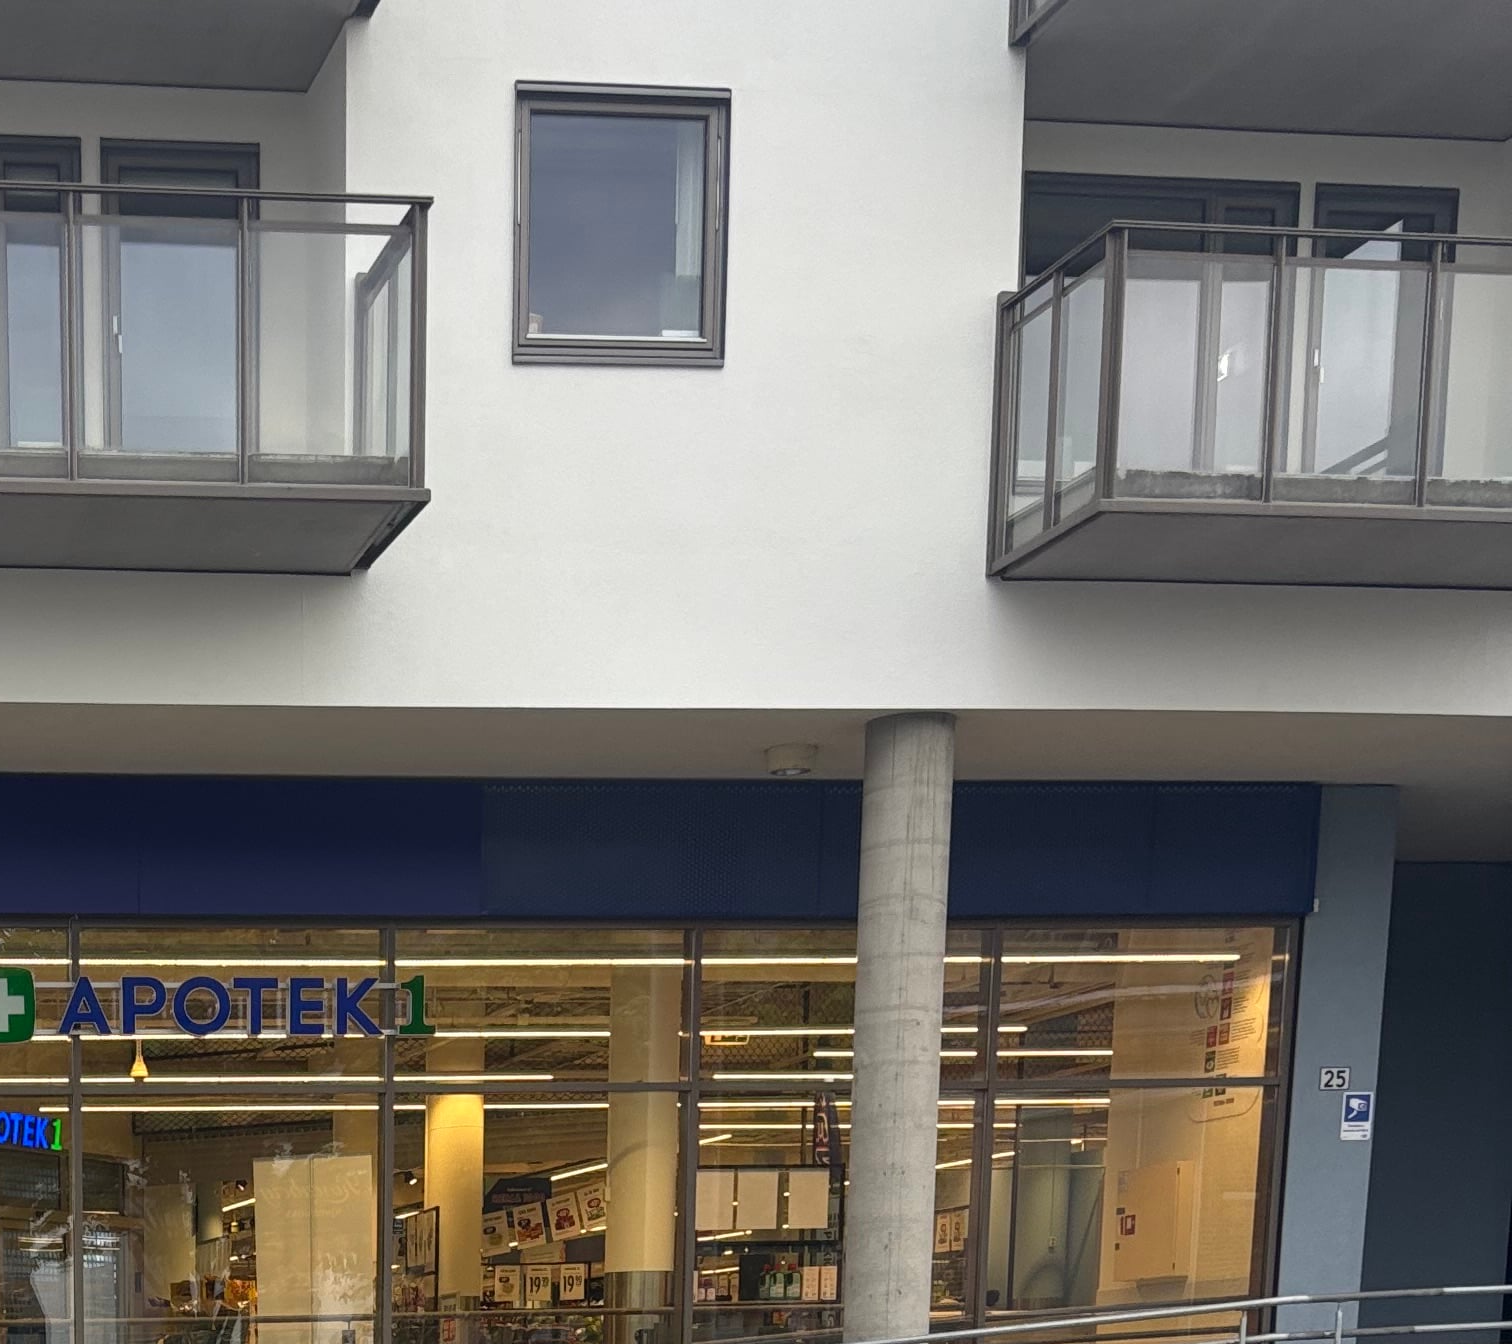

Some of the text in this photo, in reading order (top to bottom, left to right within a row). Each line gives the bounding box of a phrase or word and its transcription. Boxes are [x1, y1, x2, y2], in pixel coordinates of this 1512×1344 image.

[58, 974, 437, 1037] APOTEK 1
[1324, 1070, 1346, 1088] 25
[50, 1119, 63, 1150] 1
